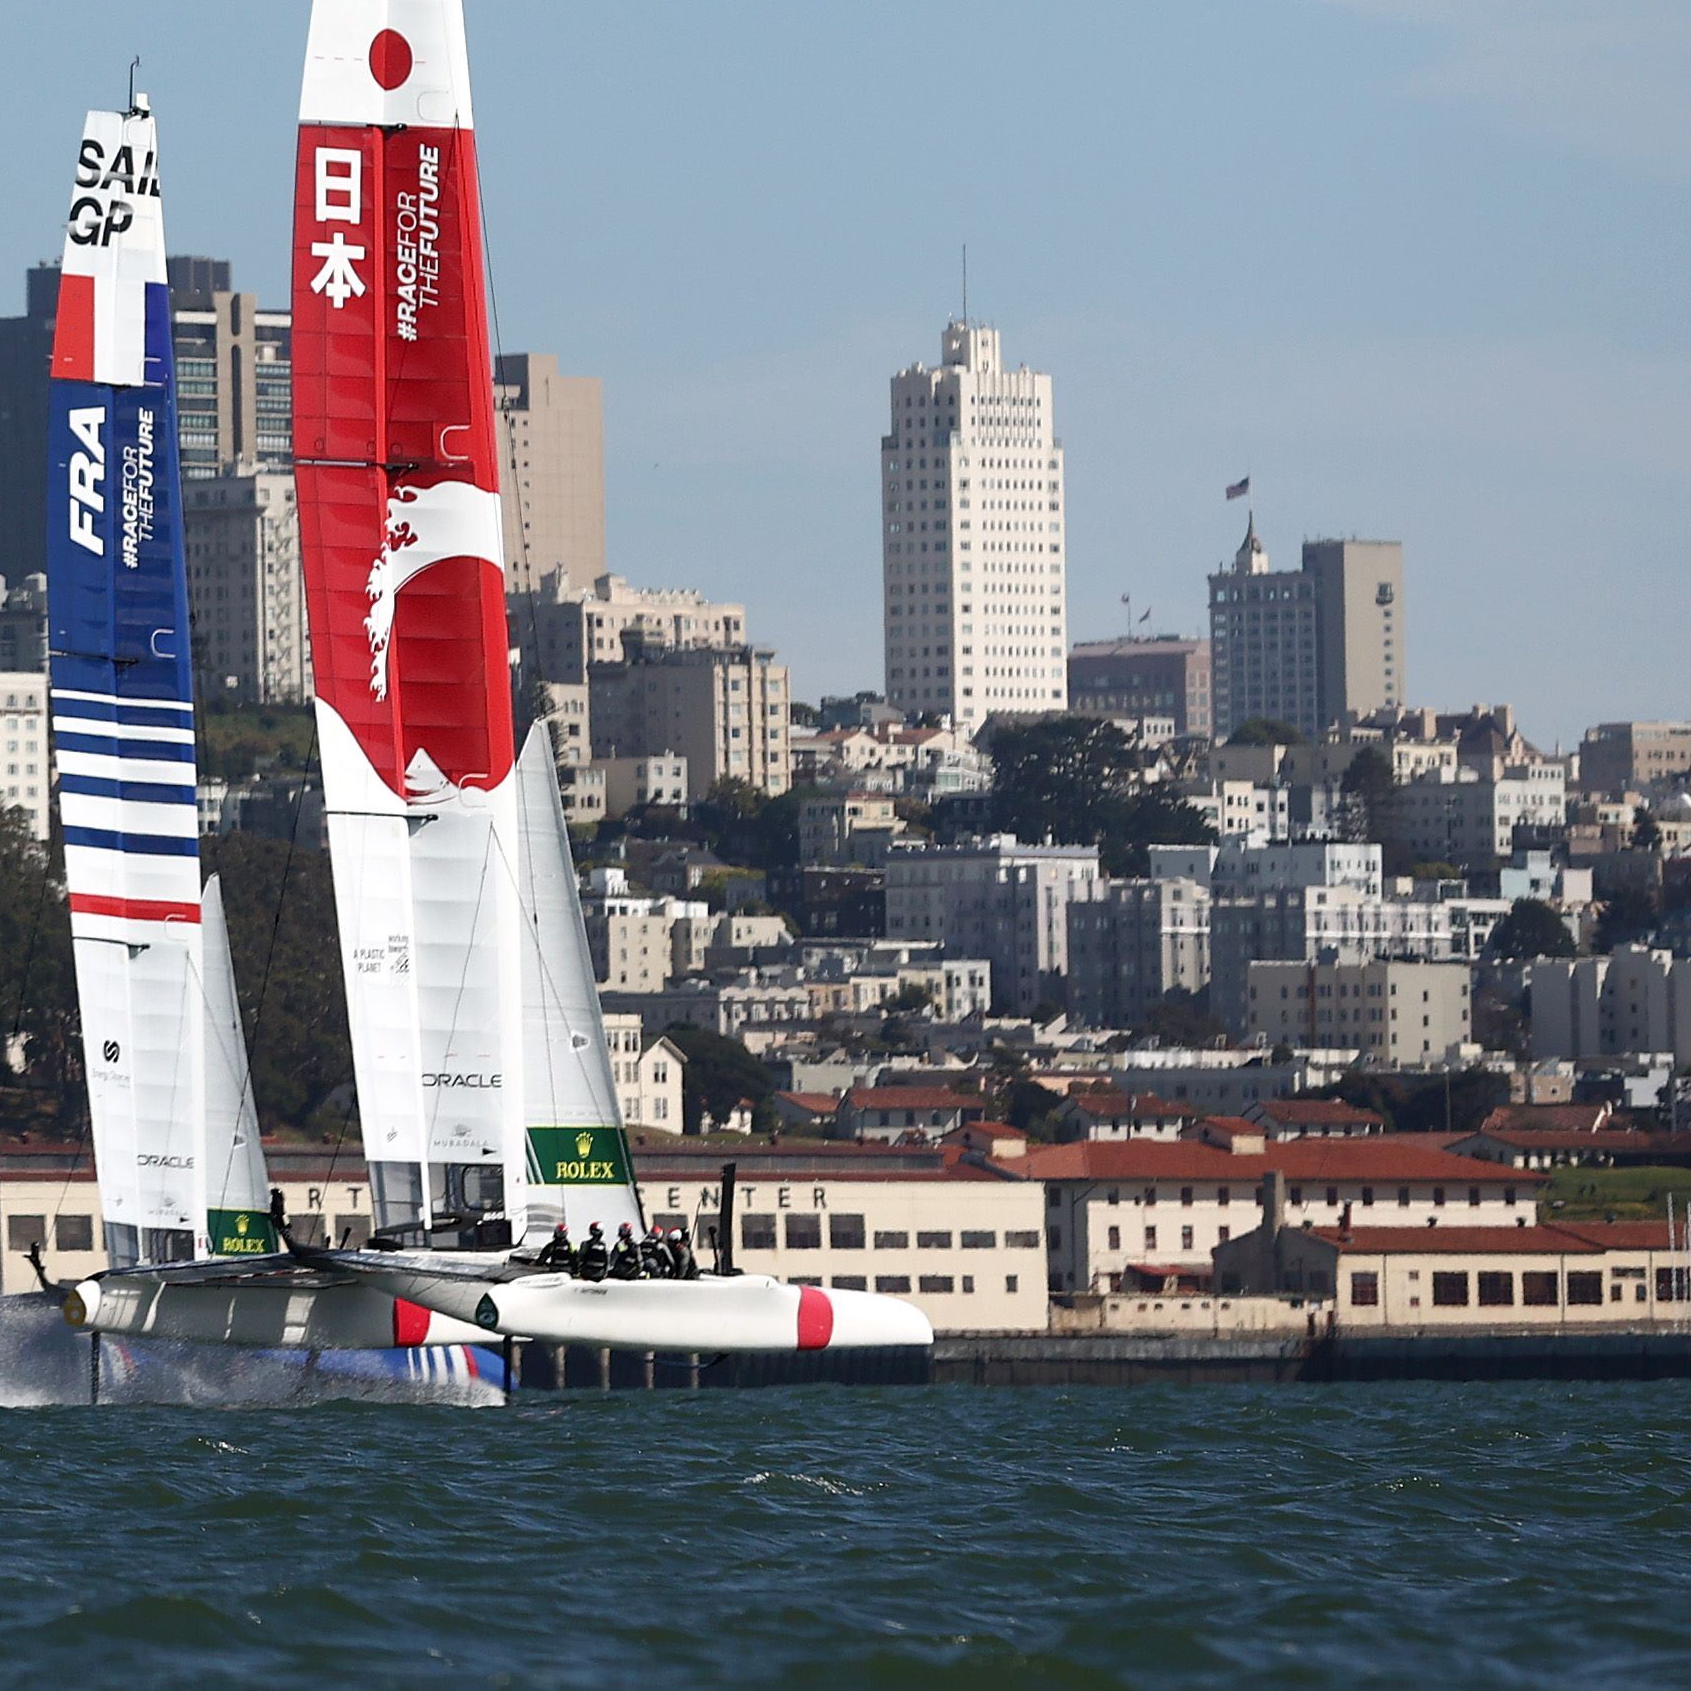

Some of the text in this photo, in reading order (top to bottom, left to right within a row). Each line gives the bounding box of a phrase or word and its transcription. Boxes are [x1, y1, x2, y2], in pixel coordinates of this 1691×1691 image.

[75, 139, 160, 197] SAIL
[69, 196, 133, 247] GP
[310, 146, 366, 308] 日本
[69, 406, 106, 557] FRA
[422, 1073, 503, 1088] ORACLE
[137, 1154, 195, 1169] ORACLE
[556, 1161, 615, 1179] ROLEX
[222, 1236, 265, 1253] ROLEX
